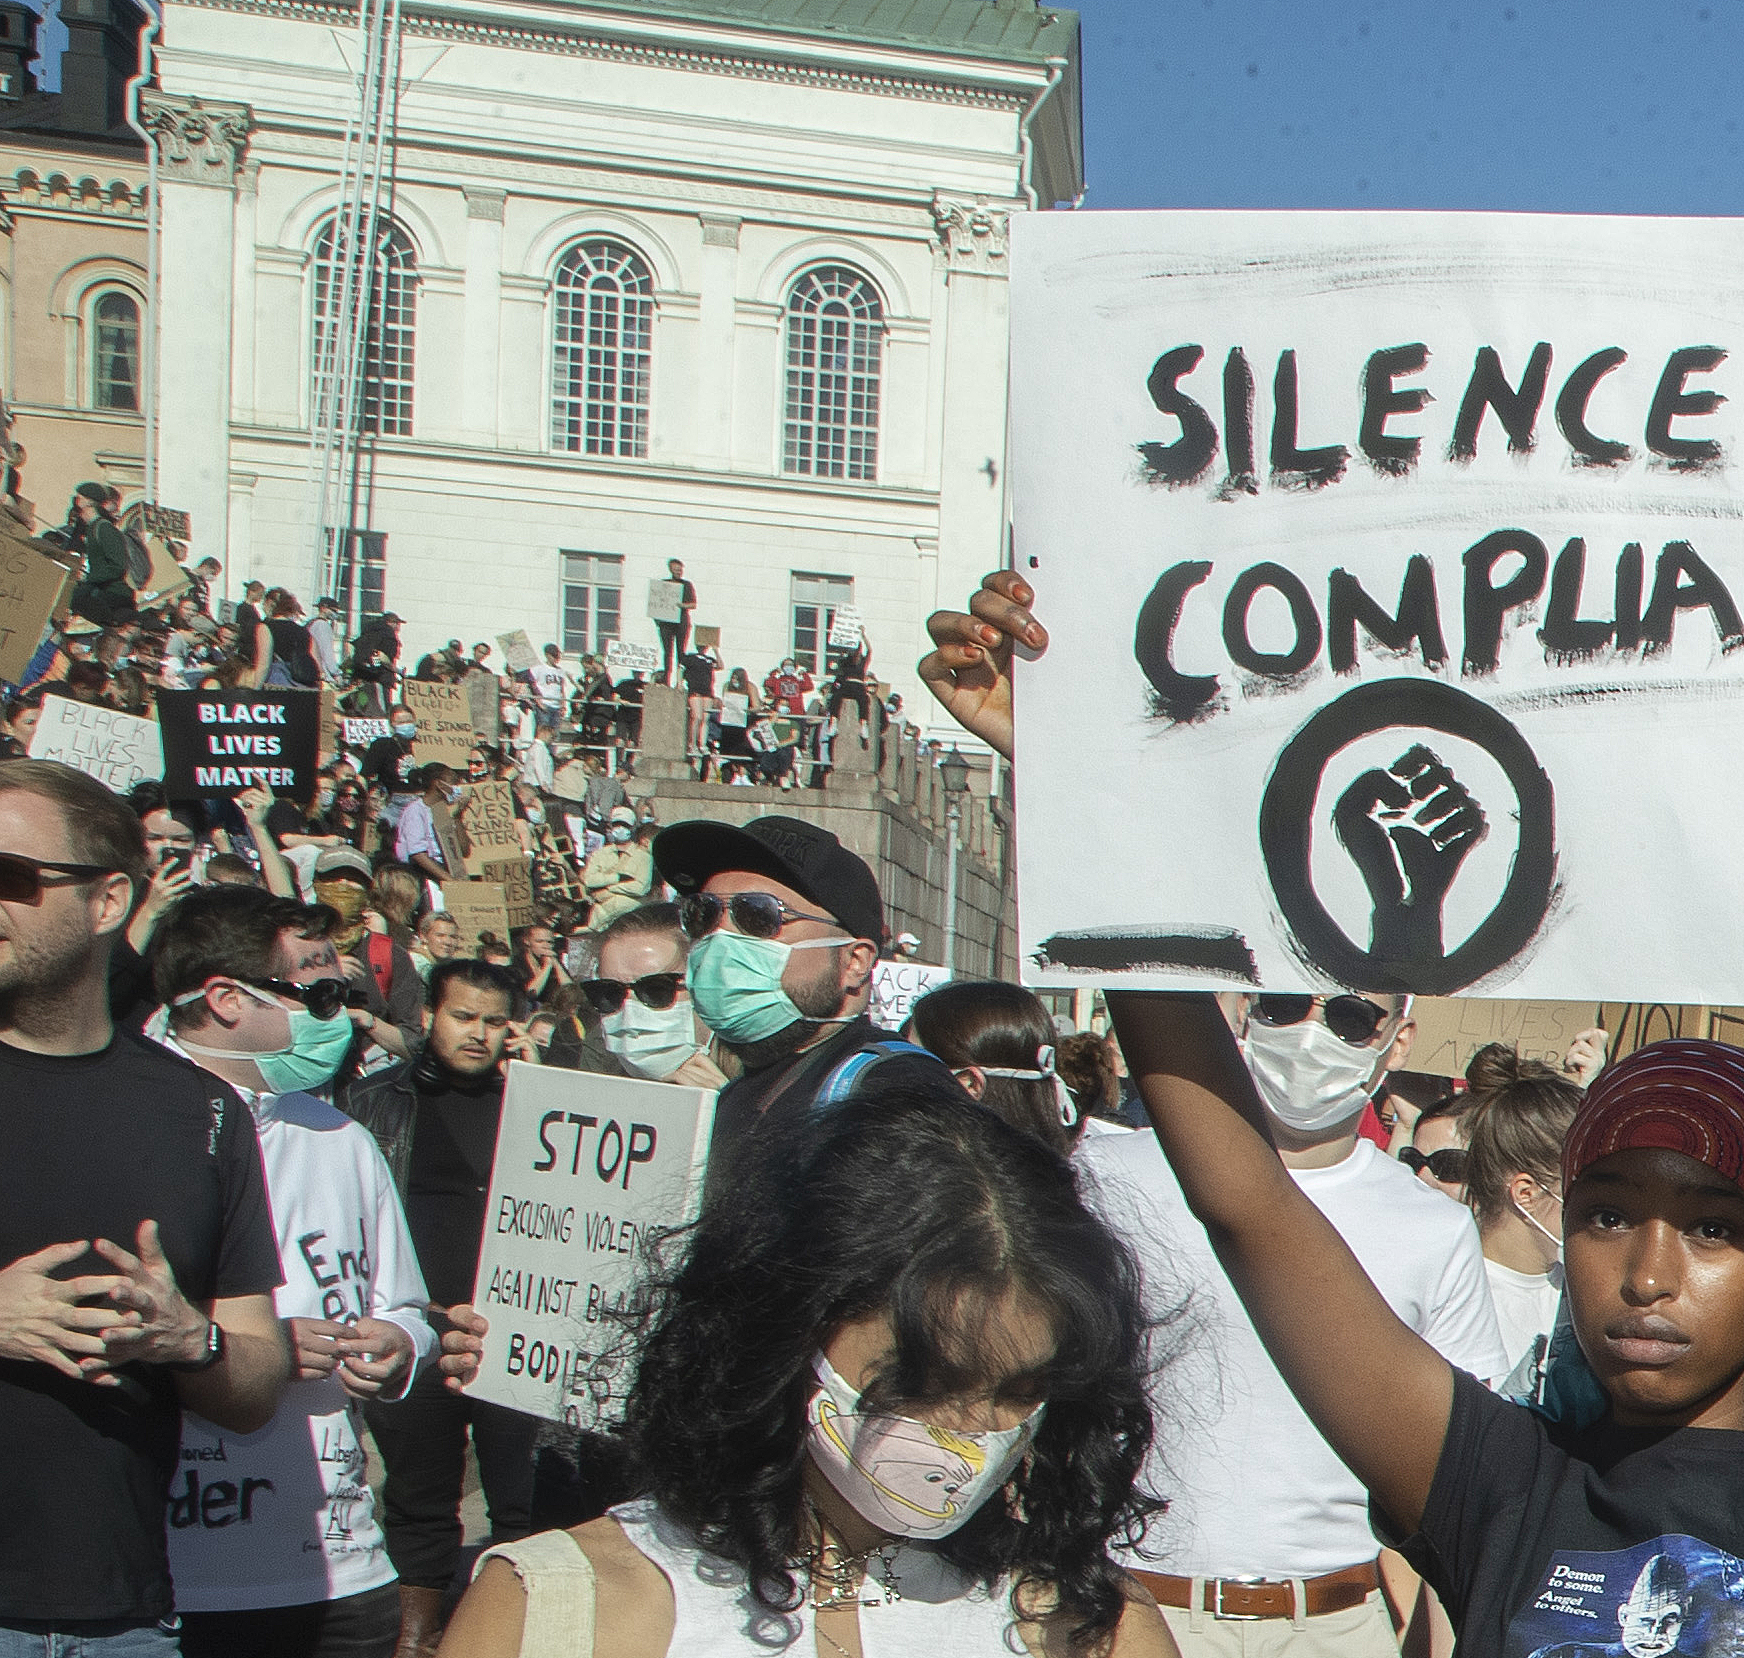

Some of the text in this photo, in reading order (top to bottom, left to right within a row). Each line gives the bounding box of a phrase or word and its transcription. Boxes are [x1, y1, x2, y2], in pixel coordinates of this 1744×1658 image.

[1138, 342, 1730, 500] SILENCE
[407, 681, 461, 700] BLACK
[62, 702, 148, 741] BLACK
[198, 703, 286, 724] BLACK
[72, 730, 139, 765] LIVES
[208, 735, 282, 755] LIVES
[196, 766, 295, 786] MATTER
[470, 785, 511, 802] ACK
[467, 803, 510, 820] VES
[466, 820, 515, 833] CKING
[470, 830, 520, 847] TTER
[880, 967, 932, 992] ACK
[1458, 1000, 1567, 1041] LIVES
[532, 1110, 658, 1190] STOP
[496, 1195, 668, 1258] EXCUSING VIOLEN
[298, 1218, 370, 1289] End
[487, 1265, 578, 1318] AGAINST
[181, 1437, 226, 1462] oned
[168, 1469, 276, 1530] der
[1553, 1565, 1605, 1582] Demon
[1548, 1577, 1604, 1593] to some.
[1538, 1590, 1584, 1606] Angel
[1534, 1601, 1599, 1619] to others.
